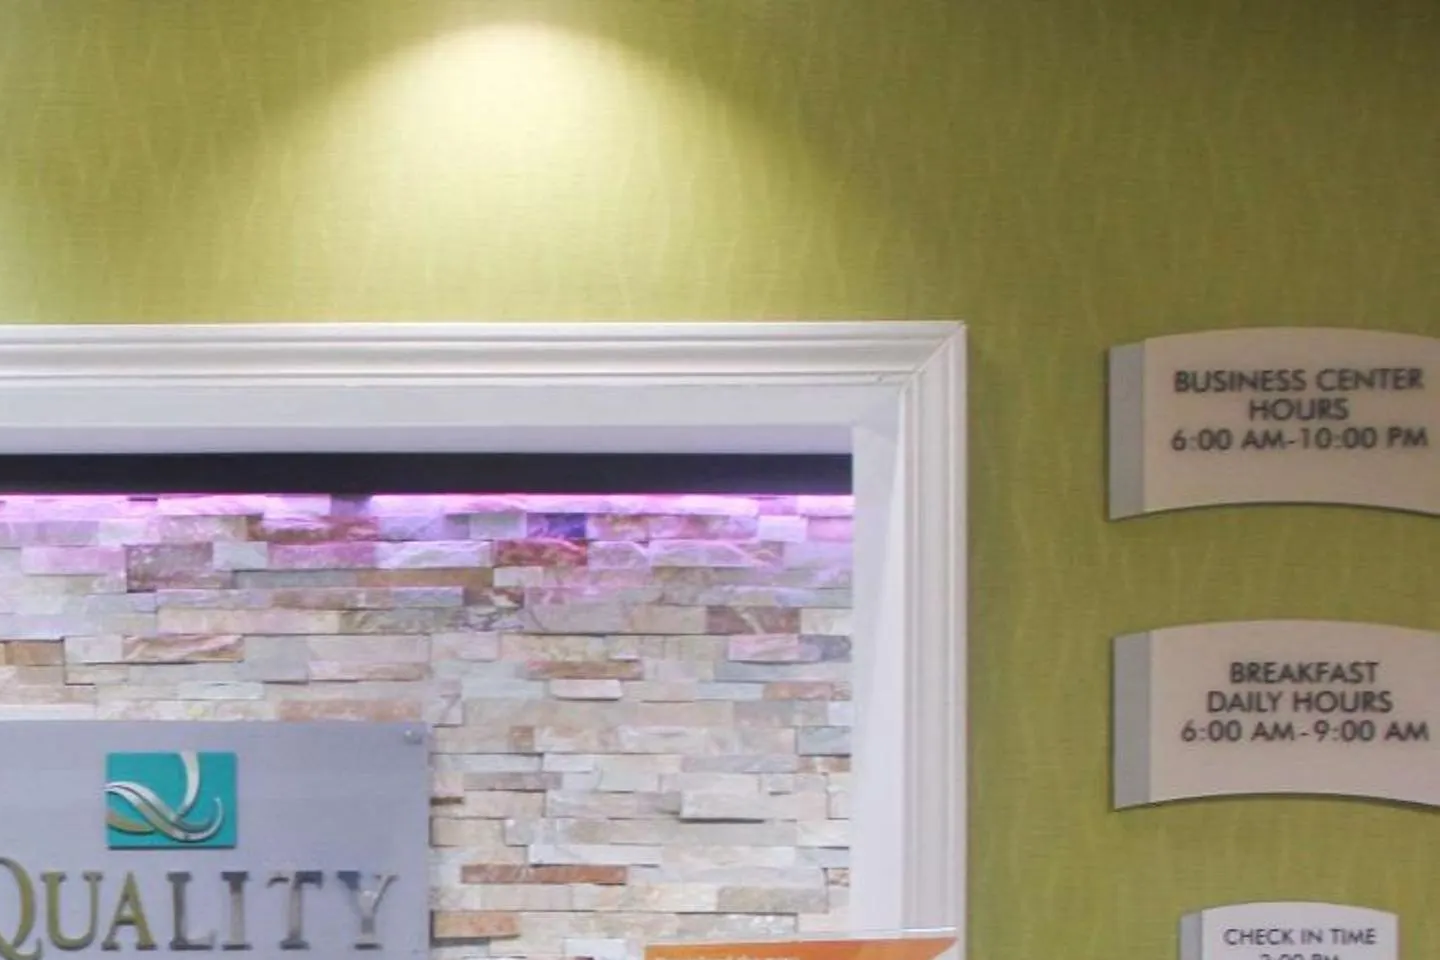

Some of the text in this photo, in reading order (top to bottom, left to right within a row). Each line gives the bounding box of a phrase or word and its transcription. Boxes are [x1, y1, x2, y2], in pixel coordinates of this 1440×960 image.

[1174, 368, 1424, 393] BUSINESS CENTER
[1248, 398, 1349, 421] HOURS
[1171, 429, 1233, 451] 6:00
[1387, 426, 1429, 447] PM
[1229, 662, 1379, 685] BREAKFAST
[1206, 690, 1394, 713] DAILY HOURS
[1181, 719, 1242, 742] 6:00
[1384, 721, 1430, 742] AM
[1222, 927, 1377, 946] CHECK IN TIME
